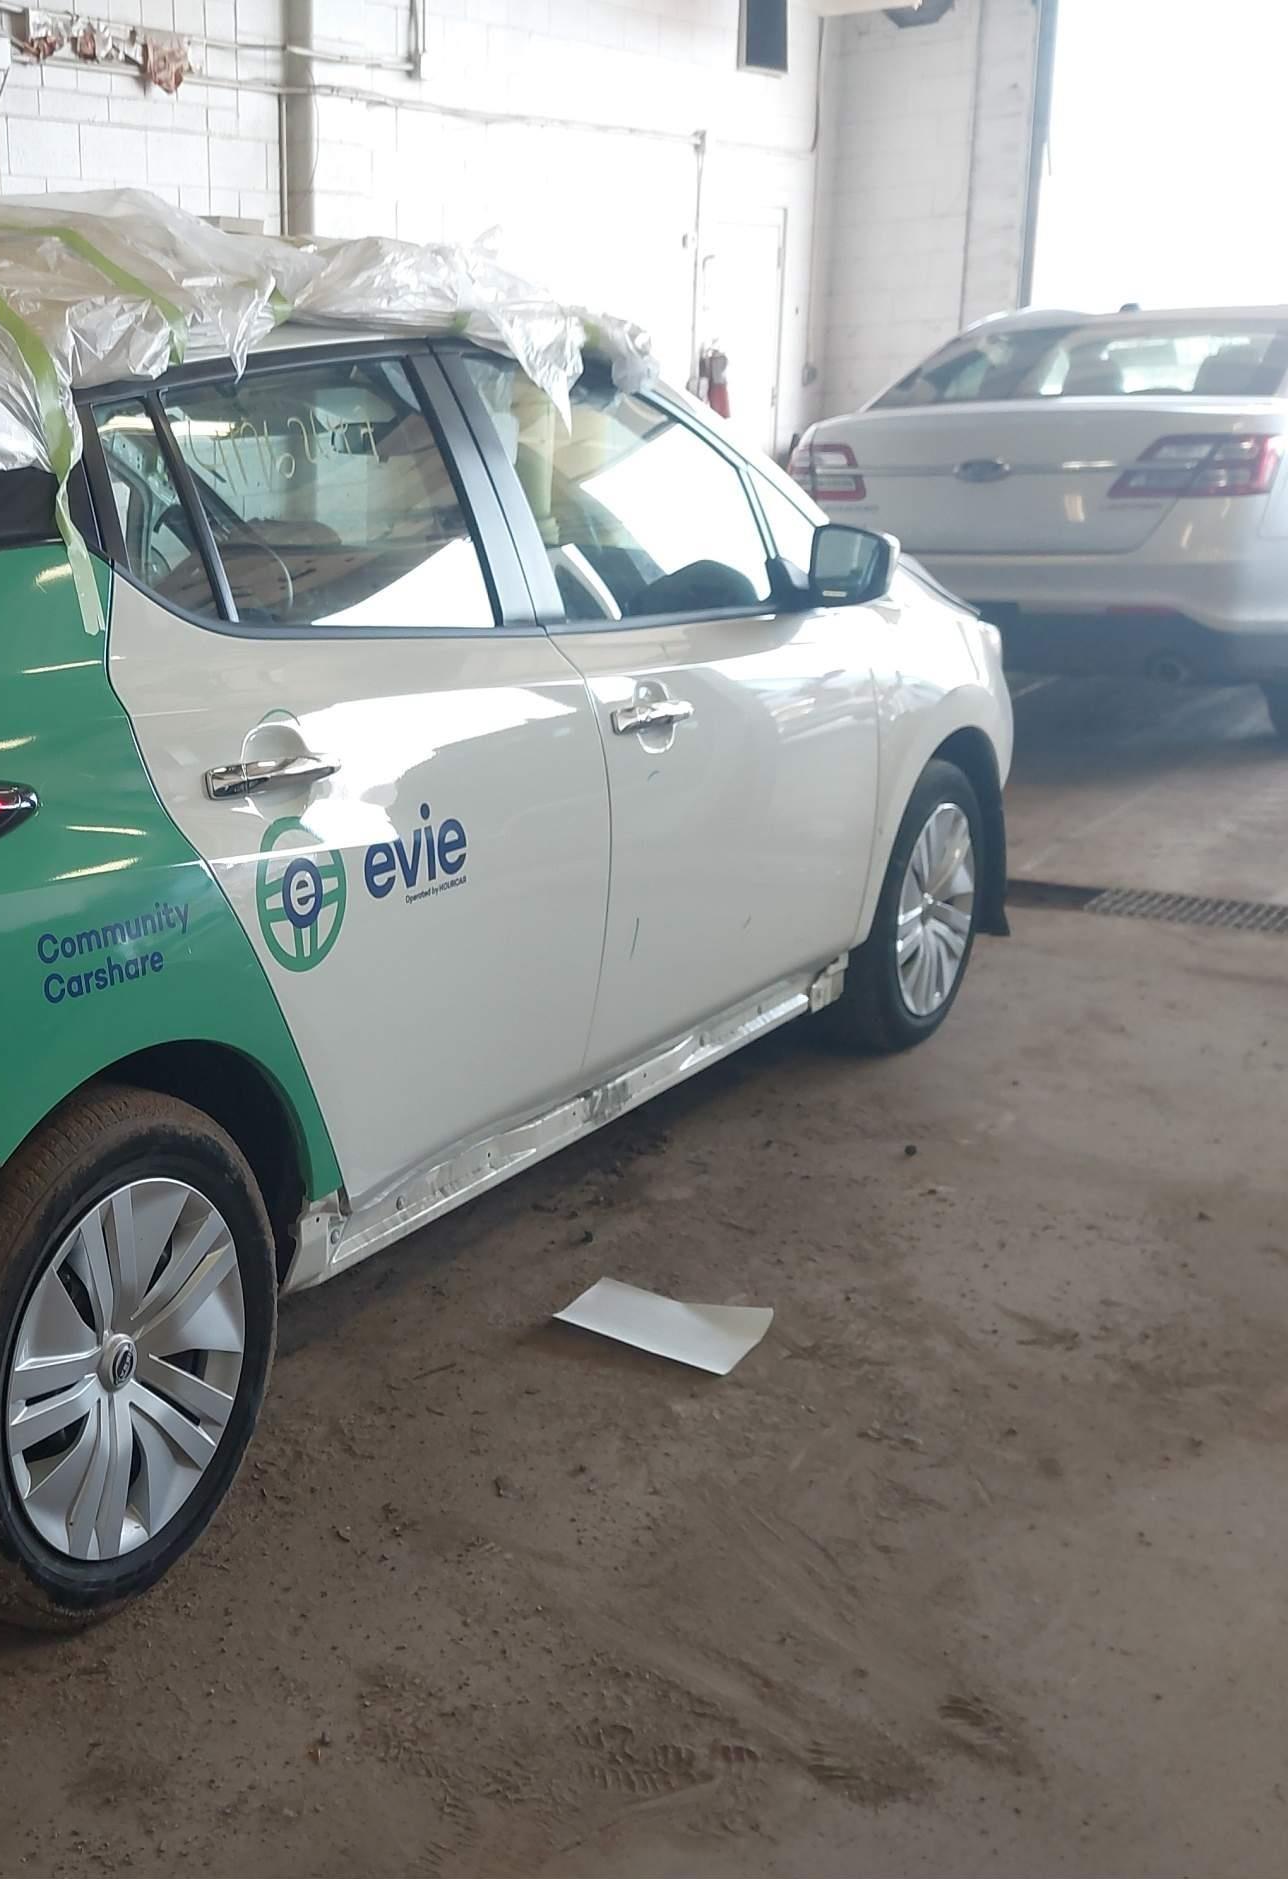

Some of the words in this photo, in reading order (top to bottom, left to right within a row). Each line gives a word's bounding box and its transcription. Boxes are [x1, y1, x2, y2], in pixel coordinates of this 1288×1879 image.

[364, 802, 467, 899] evie
[37, 902, 189, 964] Community
[44, 951, 164, 1004] Carshare
